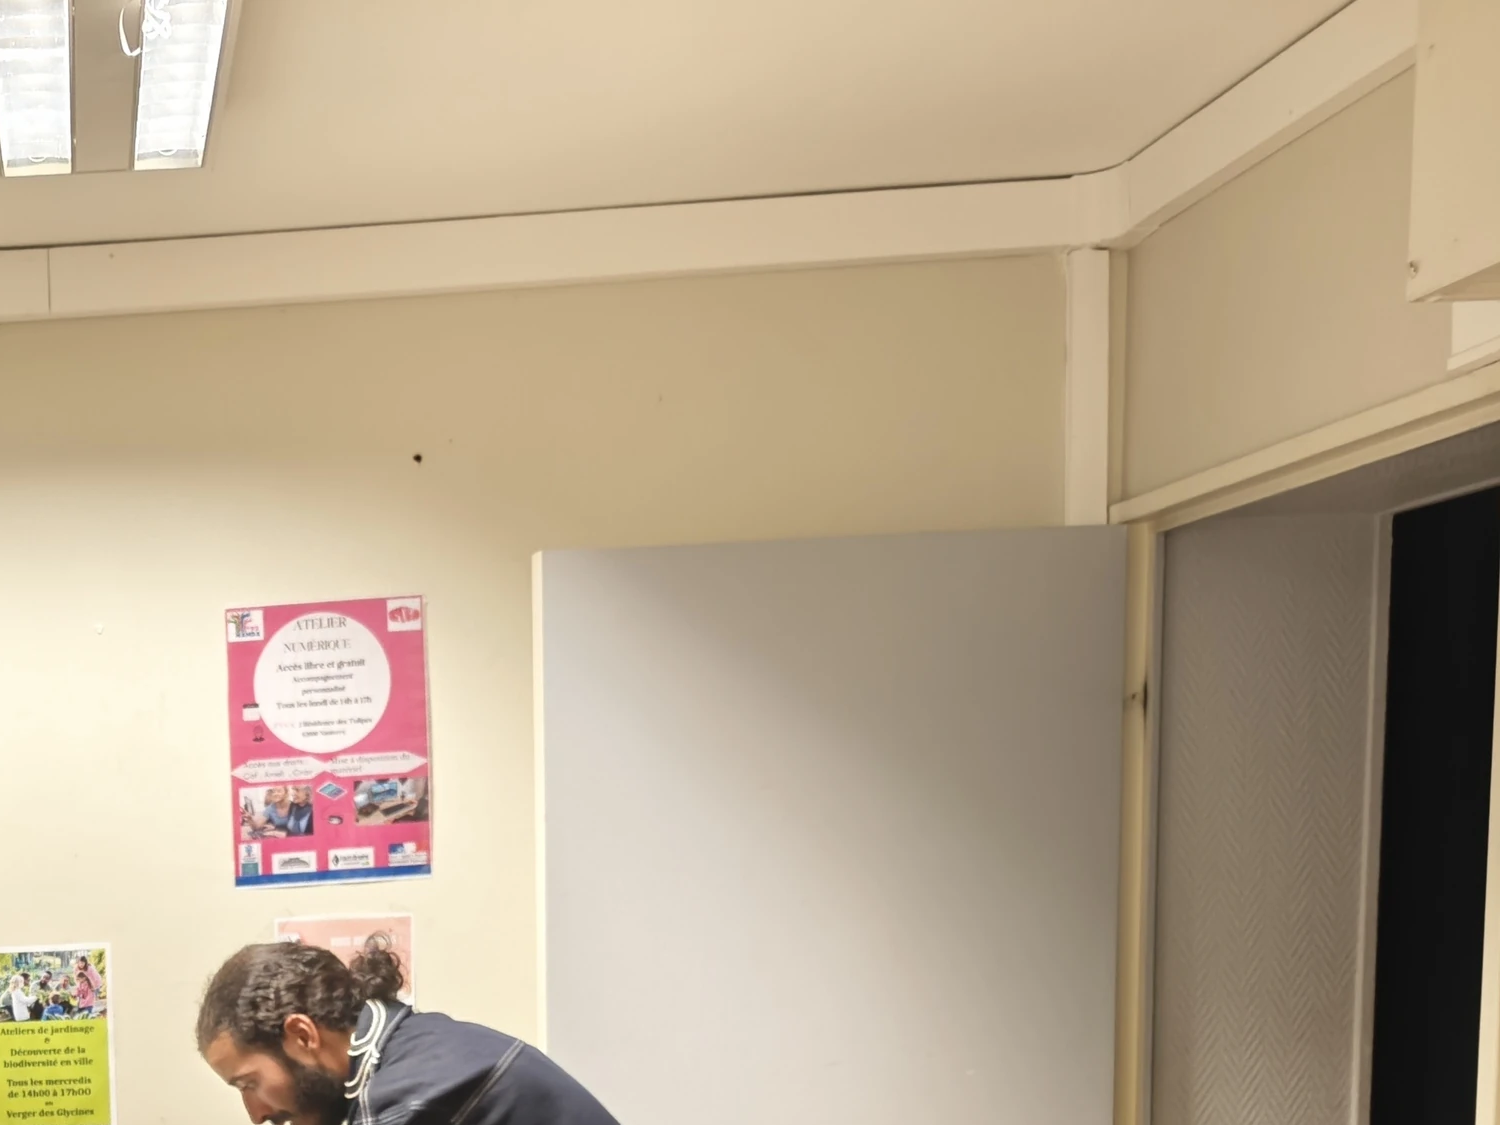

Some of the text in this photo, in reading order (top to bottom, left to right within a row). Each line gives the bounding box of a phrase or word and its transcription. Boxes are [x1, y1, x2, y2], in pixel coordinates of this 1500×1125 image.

[293, 618, 347, 631] ATELIER
[284, 639, 351, 653] NUMÉRIQUE
[277, 658, 366, 673] Accès libre et gratuit
[292, 673, 354, 685] Accompagnement
[276, 701, 295, 710] Tous
[296, 700, 308, 708] les
[308, 699, 328, 708] lundi
[329, 698, 338, 706] de
[0, 1024, 95, 1036] Ateliers de jardinage
[10, 1045, 86, 1057] Découverte de la
[3, 1058, 58, 1069] biodiversité
[73, 1057, 94, 1066] ville
[7, 1076, 92, 1087] Tous les mercredis
[7, 1087, 92, 1099] de 14h00 à 17h00
[6, 1107, 95, 1120] Verger des Glycines
